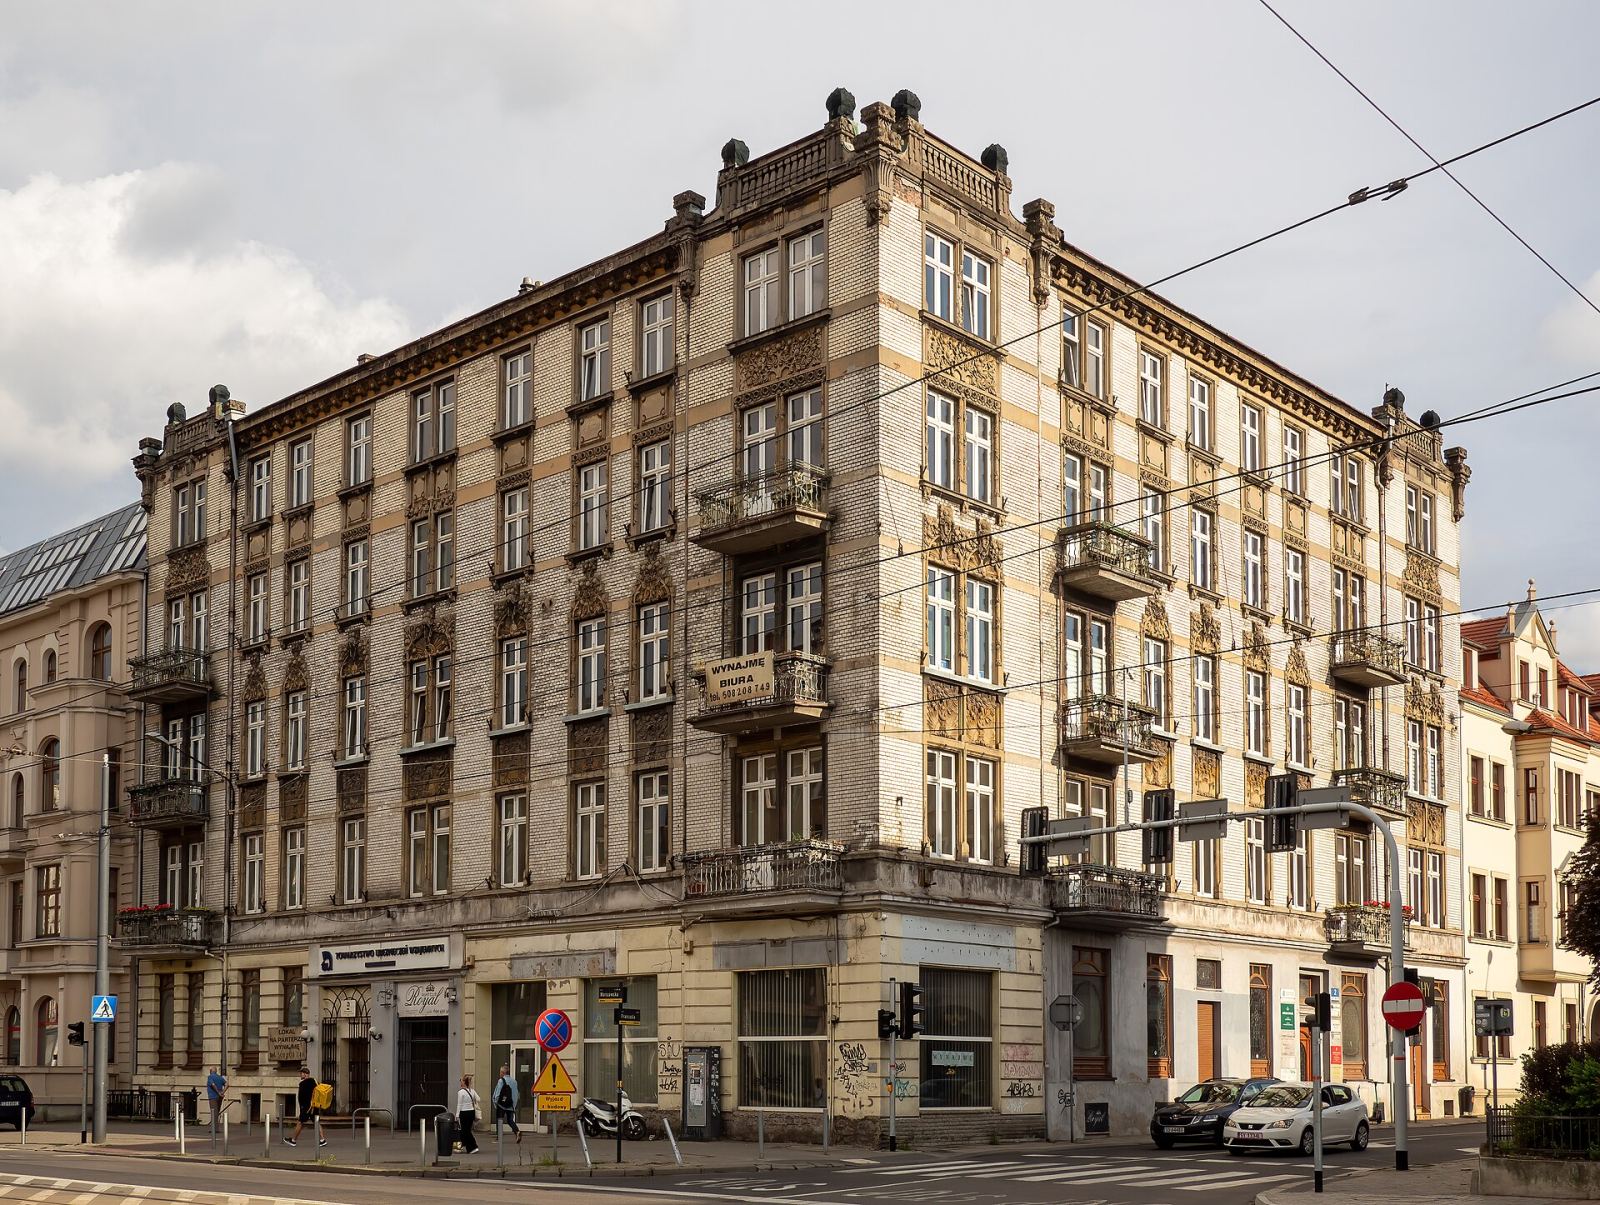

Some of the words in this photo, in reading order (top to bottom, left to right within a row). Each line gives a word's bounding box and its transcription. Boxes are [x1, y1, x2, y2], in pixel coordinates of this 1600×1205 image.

[711, 657, 766, 675] WYNAJMĘ
[719, 674, 754, 688] BIURA
[709, 690, 721, 702] tel.
[404, 984, 444, 1014] Royal
